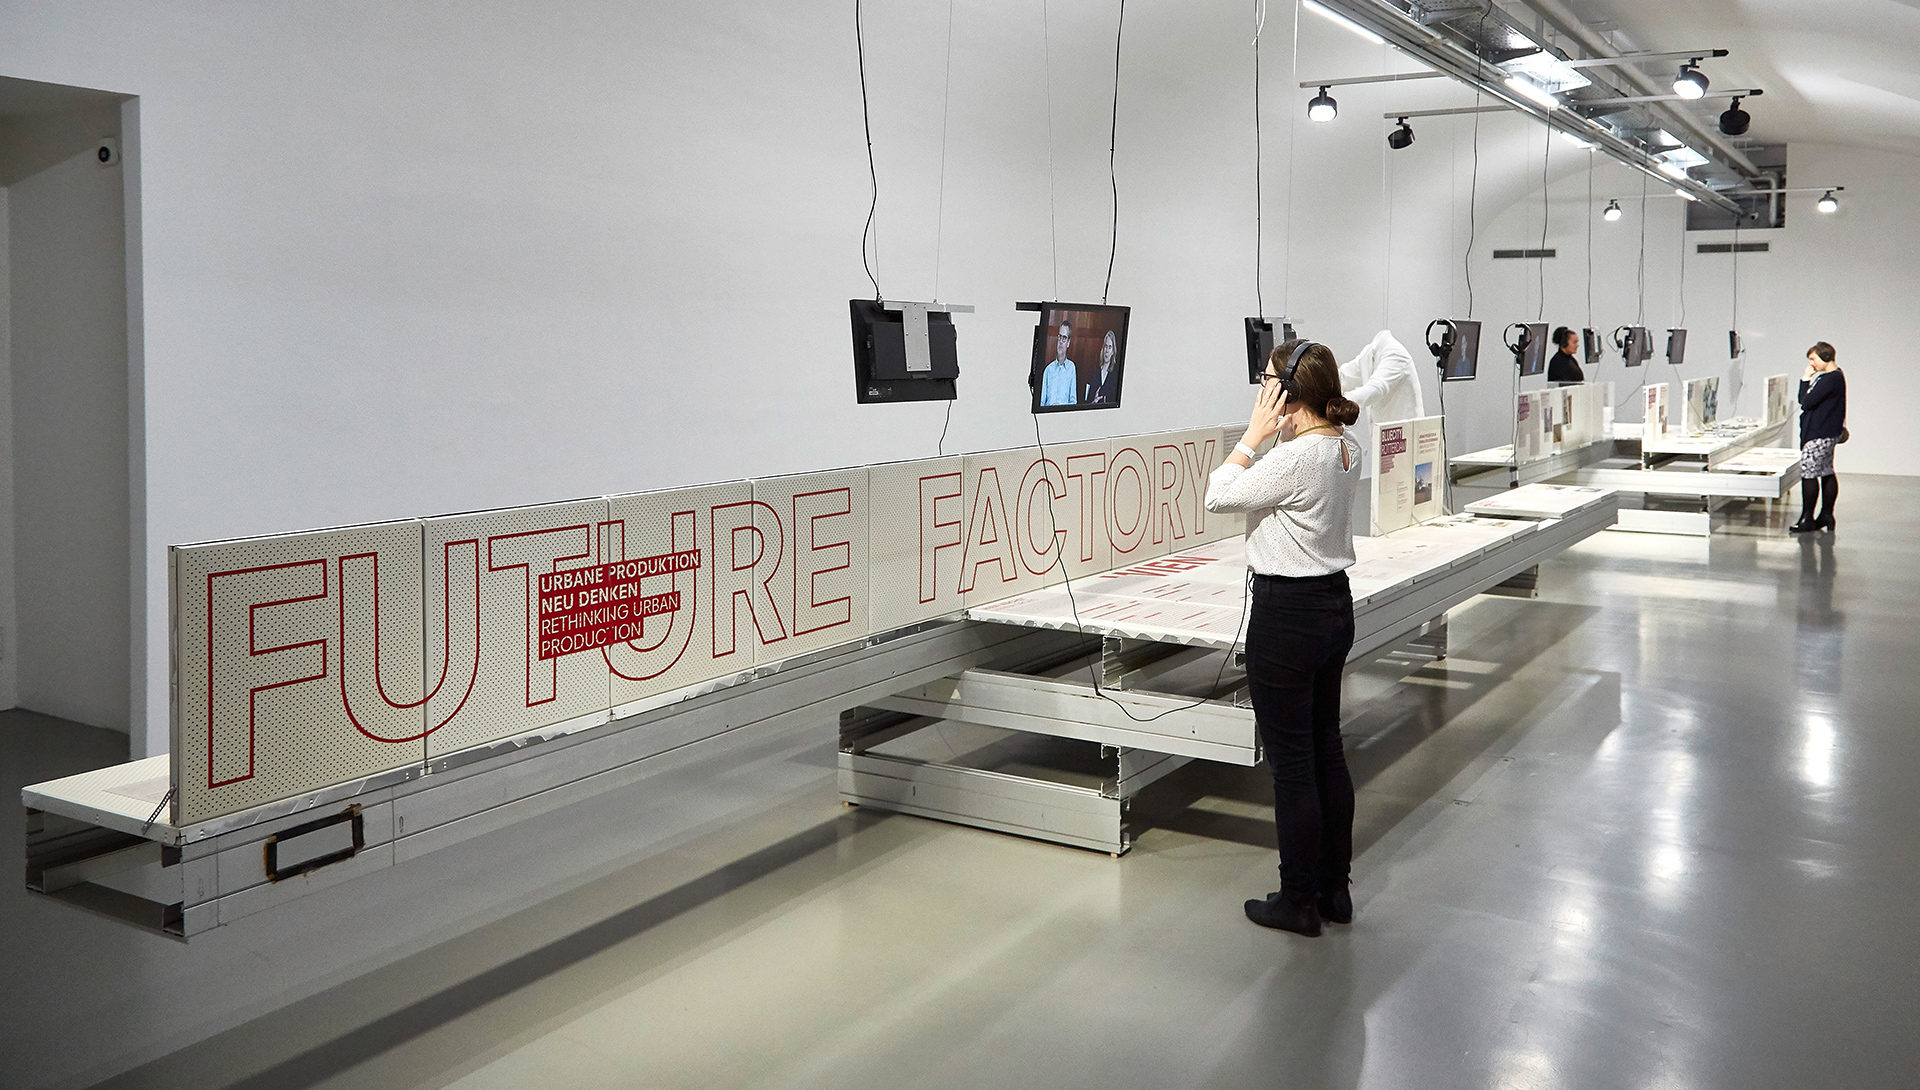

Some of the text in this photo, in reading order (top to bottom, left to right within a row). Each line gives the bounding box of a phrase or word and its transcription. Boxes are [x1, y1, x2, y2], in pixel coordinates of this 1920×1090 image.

[541, 551, 699, 592] URBANE PRODUKTION
[208, 439, 1216, 789] FUTURE FACTORY
[541, 582, 638, 614] NEU DENKEN
[541, 593, 678, 635] RETHINKING URBAN
[541, 622, 641, 657] PRODUCION
